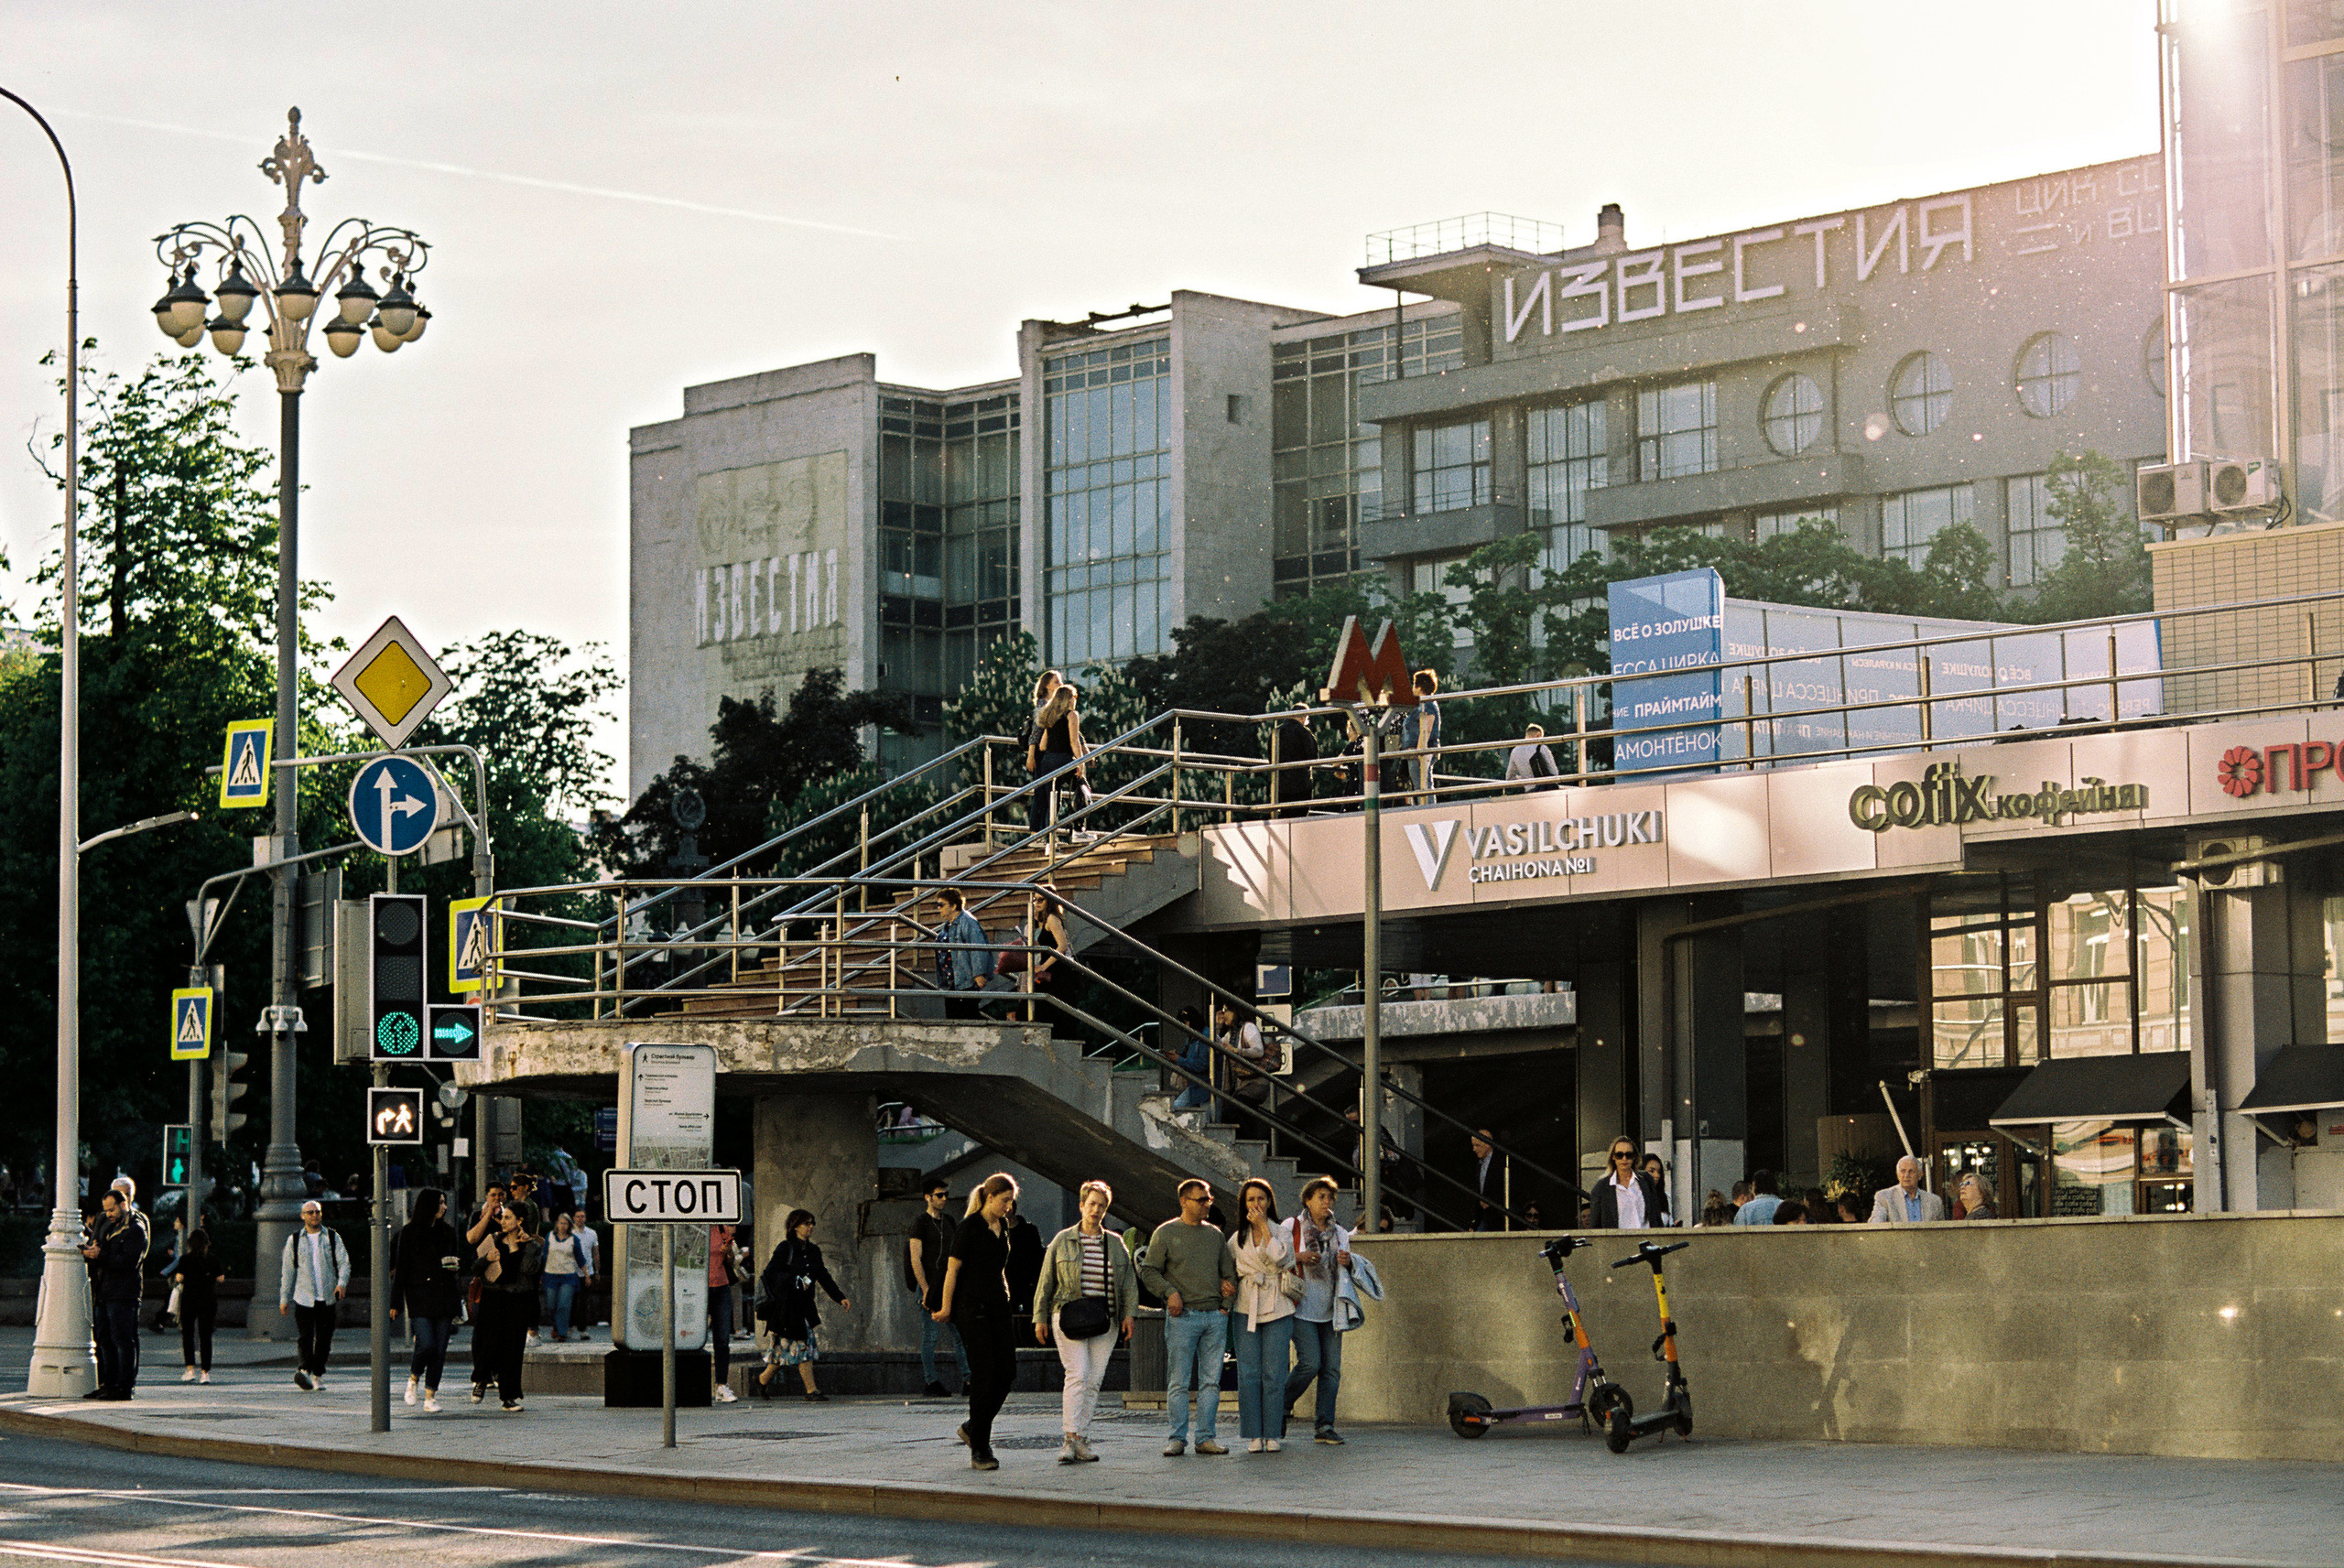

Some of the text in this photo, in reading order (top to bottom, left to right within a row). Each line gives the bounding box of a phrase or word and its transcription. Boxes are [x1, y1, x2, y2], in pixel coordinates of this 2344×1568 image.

[2015, 171, 2098, 217] ЦИК
[1503, 193, 1972, 343] ИЗВЕСТИЯ
[695, 547, 838, 649] ИЗВЕСТИЯ
[1613, 614, 1721, 643] ВСЁ О ЗОЛУШКЕ
[1634, 691, 1721, 719] ПРАЙМТАЙМ
[1613, 730, 1722, 762] АМОНТЁНОК
[1849, 762, 1994, 830] cofix
[1996, 776, 2149, 827] кофейня
[1463, 810, 1663, 859] VASILCHUKI
[624, 1179, 723, 1215] СТОП
